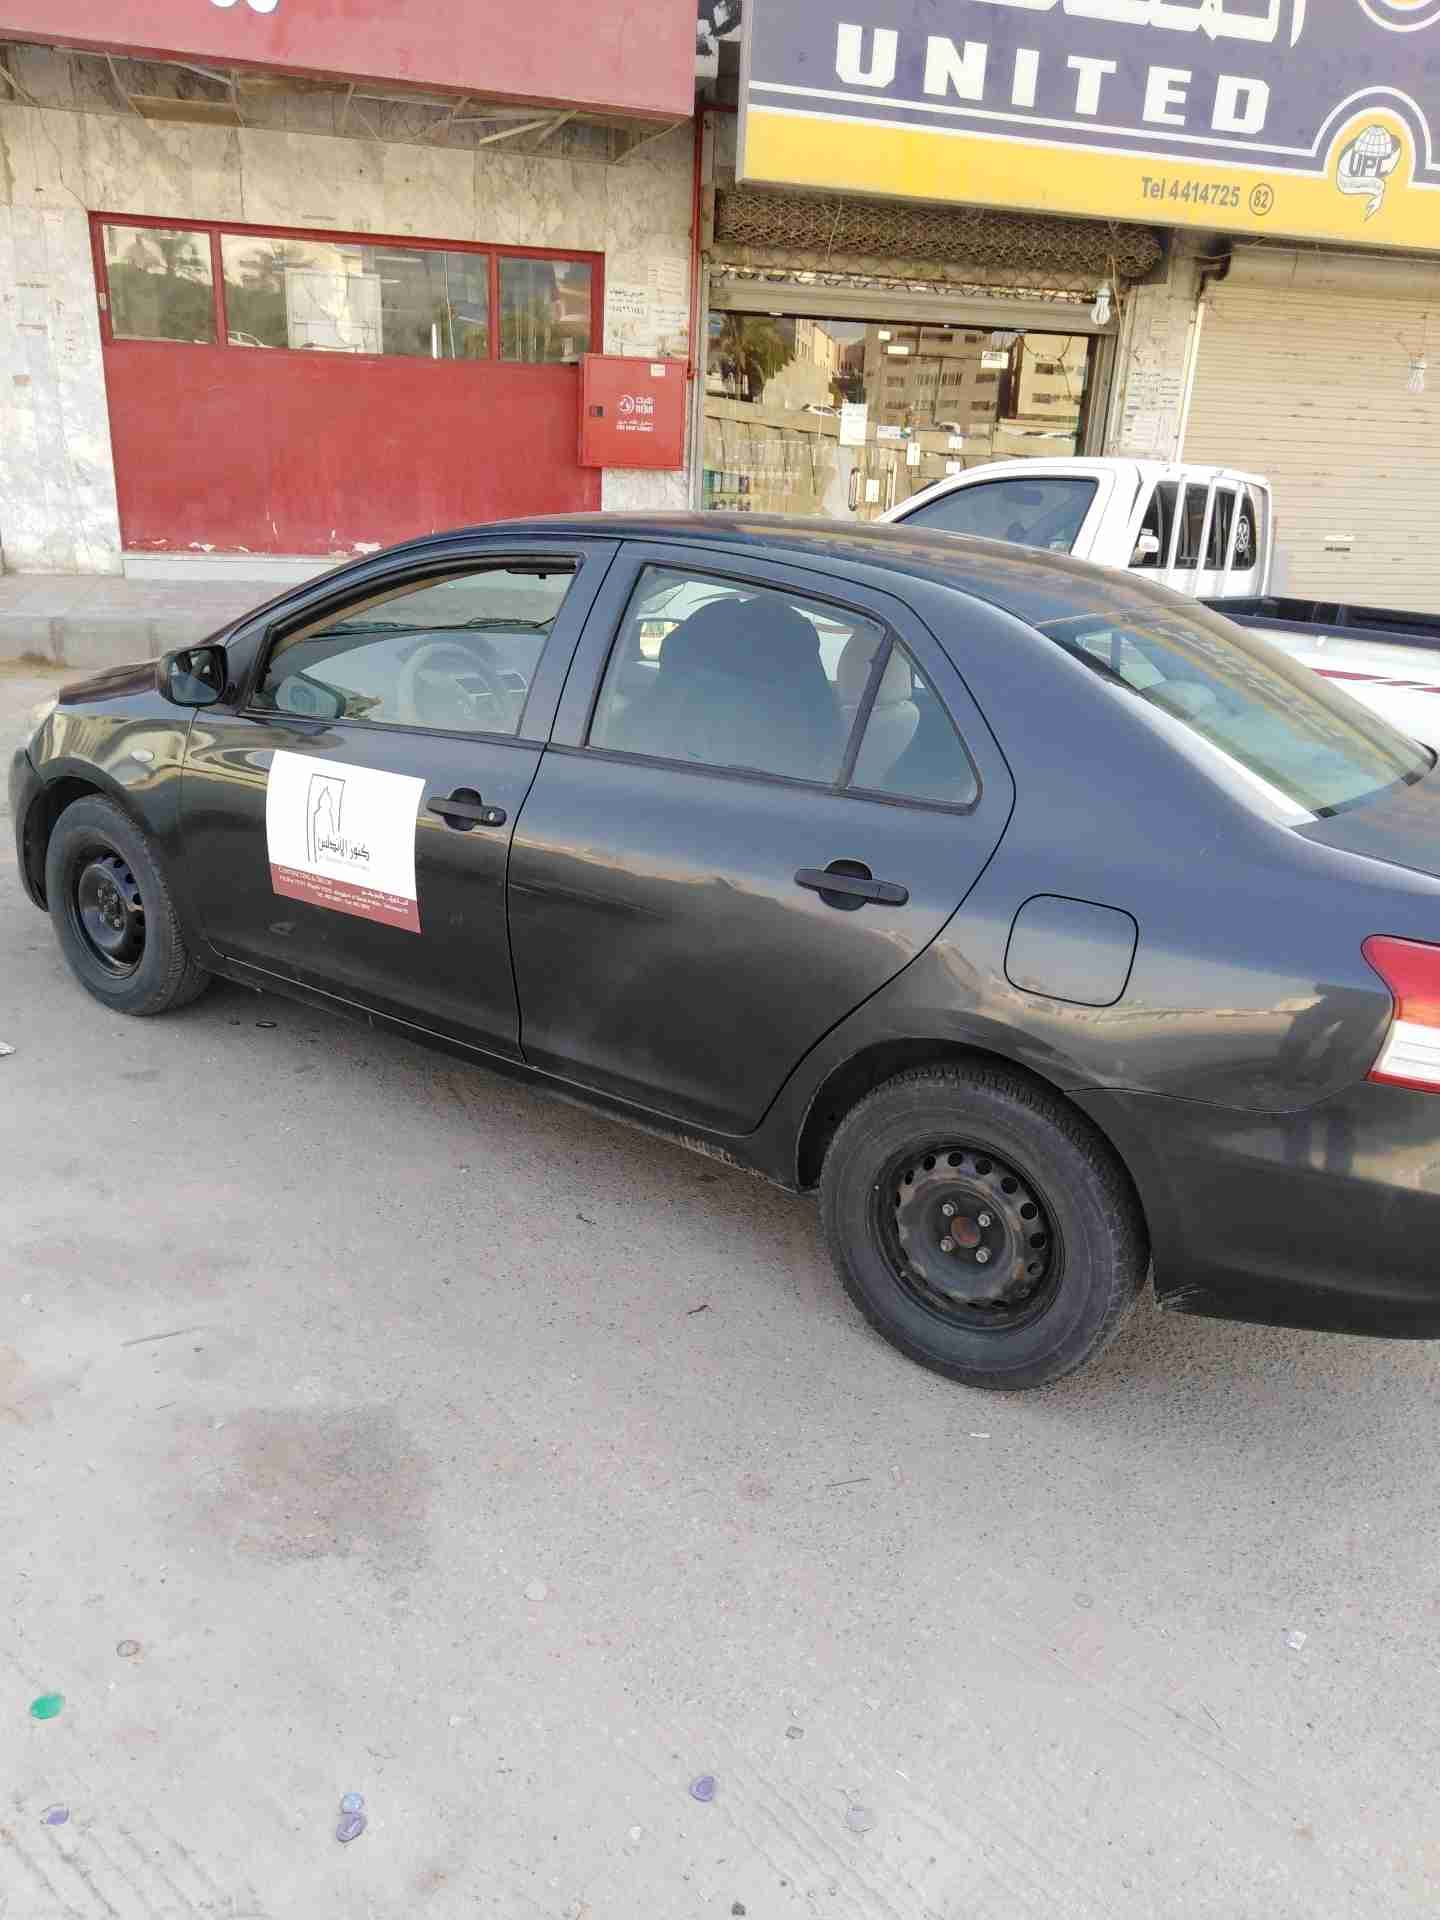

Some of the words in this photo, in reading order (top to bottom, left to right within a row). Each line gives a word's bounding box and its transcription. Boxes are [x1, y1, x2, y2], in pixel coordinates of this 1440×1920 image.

[835, 23, 1270, 134] UNITED
[1141, 176, 1166, 200] Tel
[1168, 179, 1240, 208] 4414725
[1252, 188, 1270, 209] 82
